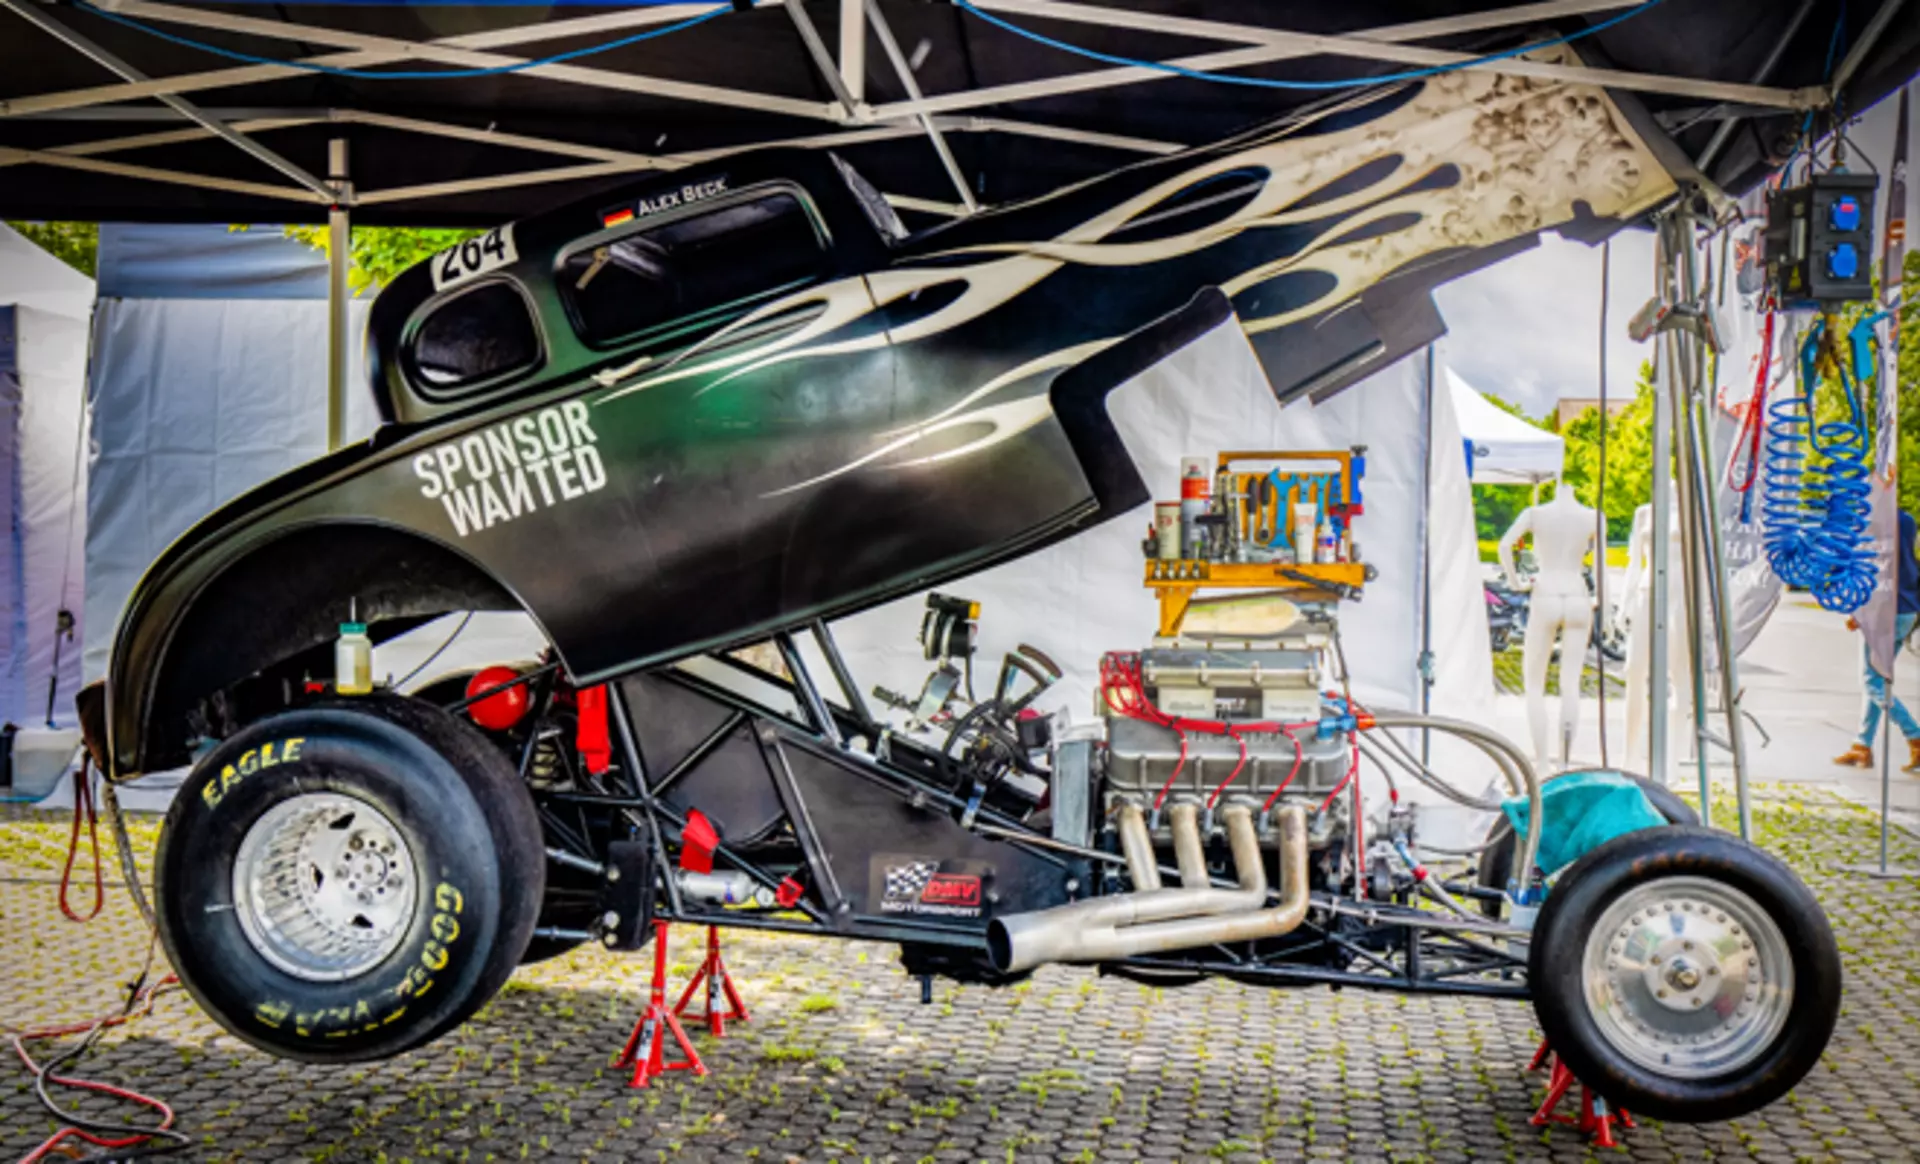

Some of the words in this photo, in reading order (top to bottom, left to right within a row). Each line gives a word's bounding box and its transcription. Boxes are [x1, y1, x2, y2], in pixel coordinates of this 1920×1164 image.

[638, 190, 683, 216] ALEX
[681, 177, 729, 203] BECK
[412, 399, 598, 499] SPONSOR
[202, 737, 306, 811] EAGLE
